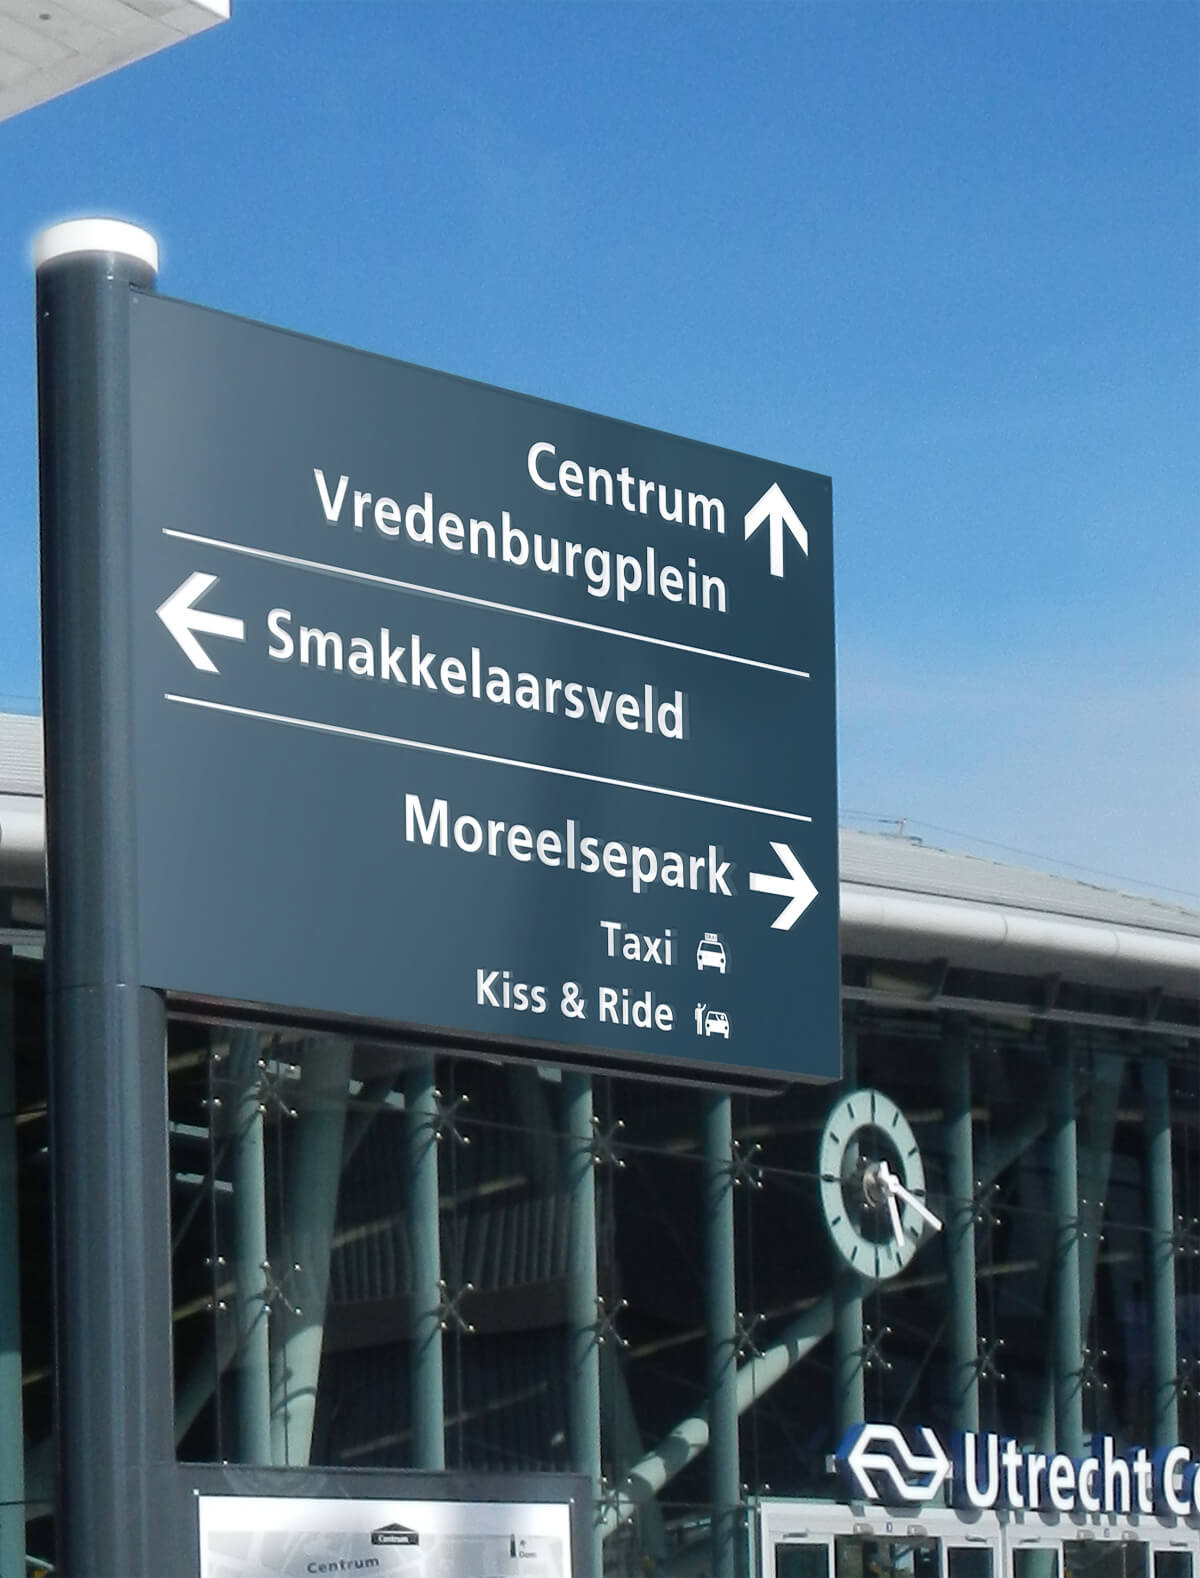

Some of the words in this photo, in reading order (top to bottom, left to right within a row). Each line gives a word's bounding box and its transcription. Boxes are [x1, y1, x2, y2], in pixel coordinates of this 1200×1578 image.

[526, 441, 726, 535] Centrum
[312, 467, 727, 613] Vredenburgplein
[266, 607, 684, 741] Smakkelaarsveld
[404, 793, 733, 896] Moreelsepark
[599, 920, 673, 966] Taxi
[476, 968, 547, 1014] Kiss
[560, 981, 587, 1020] &
[598, 986, 674, 1032] Ride
[964, 1432, 1153, 1513] Utrecht
[1163, 1445, 1200, 1515] C
[306, 1557, 380, 1574] Centrum
